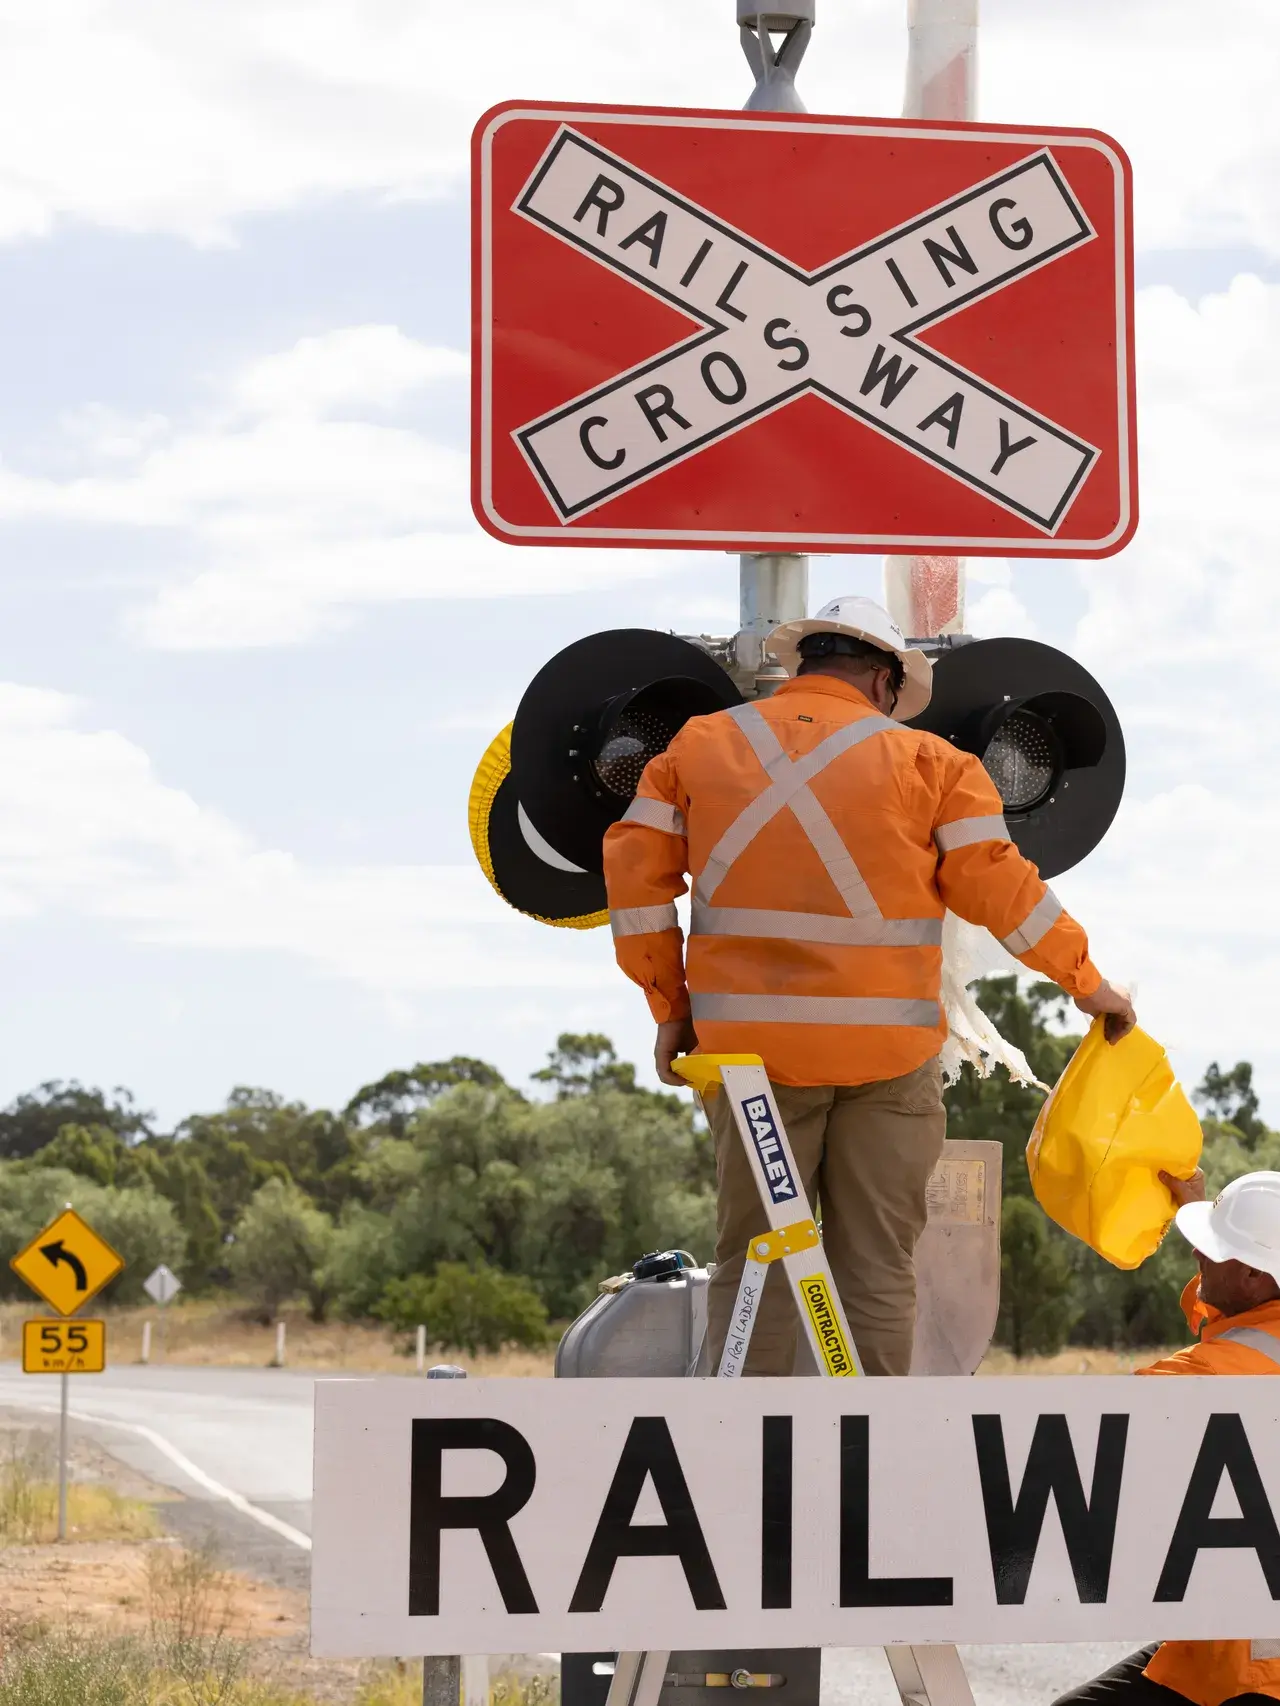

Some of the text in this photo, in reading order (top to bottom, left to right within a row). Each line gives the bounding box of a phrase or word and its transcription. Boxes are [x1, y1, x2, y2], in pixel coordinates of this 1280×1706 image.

[578, 196, 1034, 470] CROSSING
[746, 1098, 794, 1197] BAILEY
[41, 1326, 88, 1353] 55
[42, 1355, 85, 1371] km/h
[807, 1284, 847, 1374] CONTRACTOR
